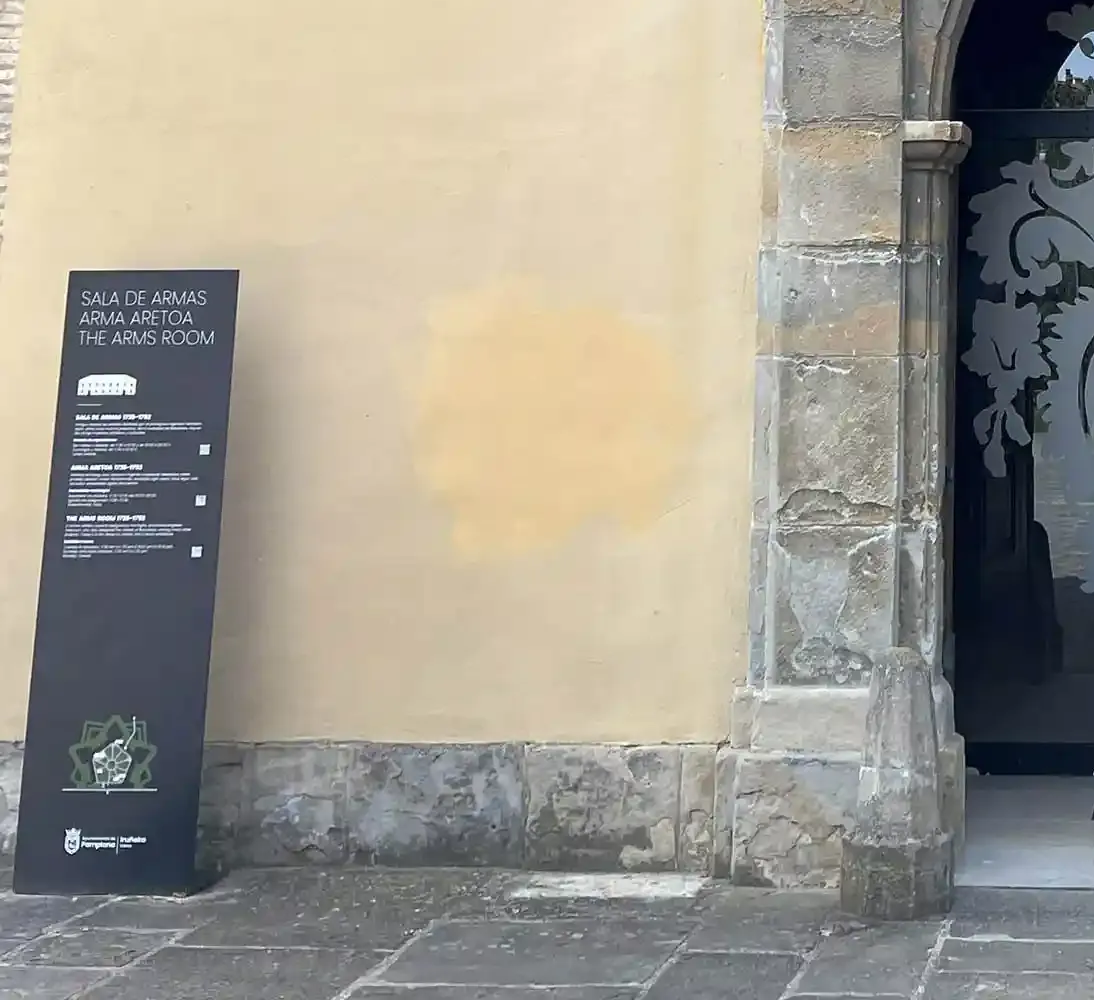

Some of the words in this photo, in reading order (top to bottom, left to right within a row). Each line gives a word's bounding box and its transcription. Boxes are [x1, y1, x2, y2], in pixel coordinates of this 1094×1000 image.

[81, 290, 119, 307] SALA
[125, 290, 146, 306] DE
[151, 290, 207, 306] ARMAS
[79, 310, 124, 326] ARMA
[129, 310, 193, 326] ARETOA
[79, 330, 106, 346] THE
[111, 330, 157, 346] ARMS
[161, 330, 215, 345] ROOM
[81, 841, 116, 850] Pamplona
